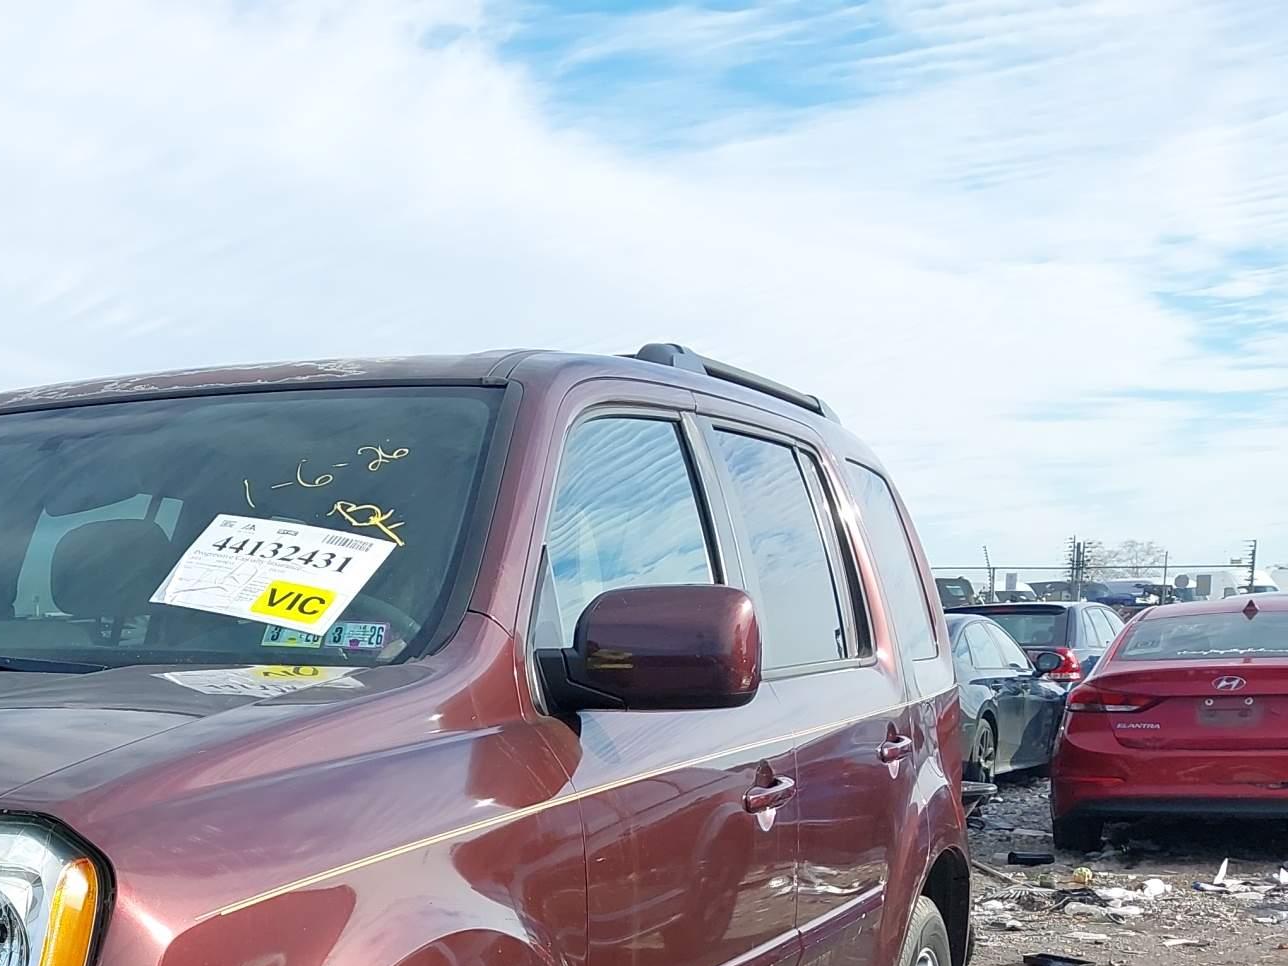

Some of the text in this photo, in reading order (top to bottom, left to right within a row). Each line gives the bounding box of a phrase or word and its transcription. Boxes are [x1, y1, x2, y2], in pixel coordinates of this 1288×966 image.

[211, 535, 353, 573] 44132431
[265, 587, 326, 616] VIC
[367, 624, 385, 646] 26
[1115, 722, 1161, 730] ELANTRA
